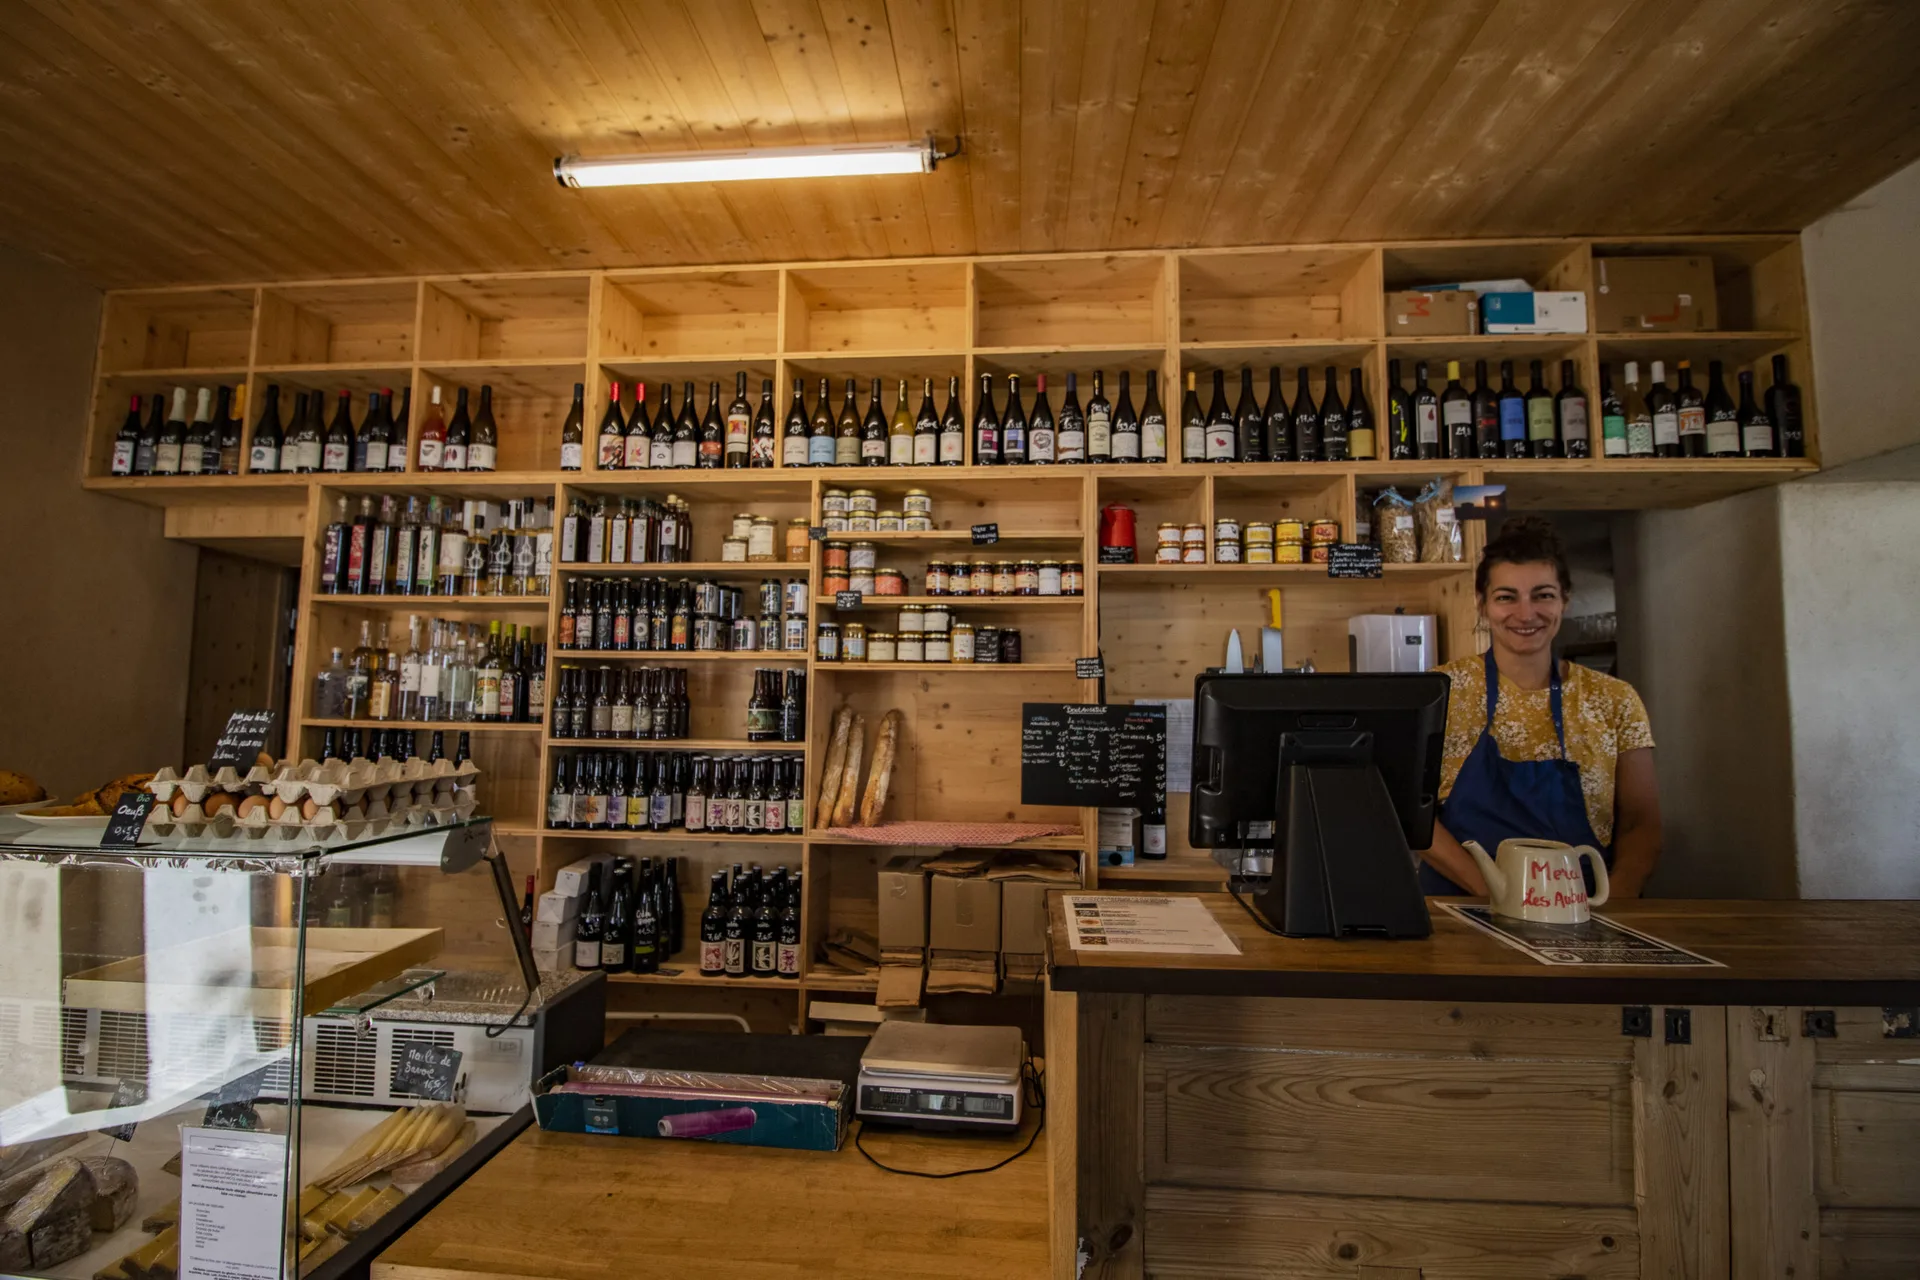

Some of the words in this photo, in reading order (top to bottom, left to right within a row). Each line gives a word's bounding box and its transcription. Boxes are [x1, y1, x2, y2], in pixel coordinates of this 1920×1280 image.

[135, 793, 151, 804] Bio
[117, 804, 145, 820] Oeufs
[1521, 887, 1551, 907] Les
